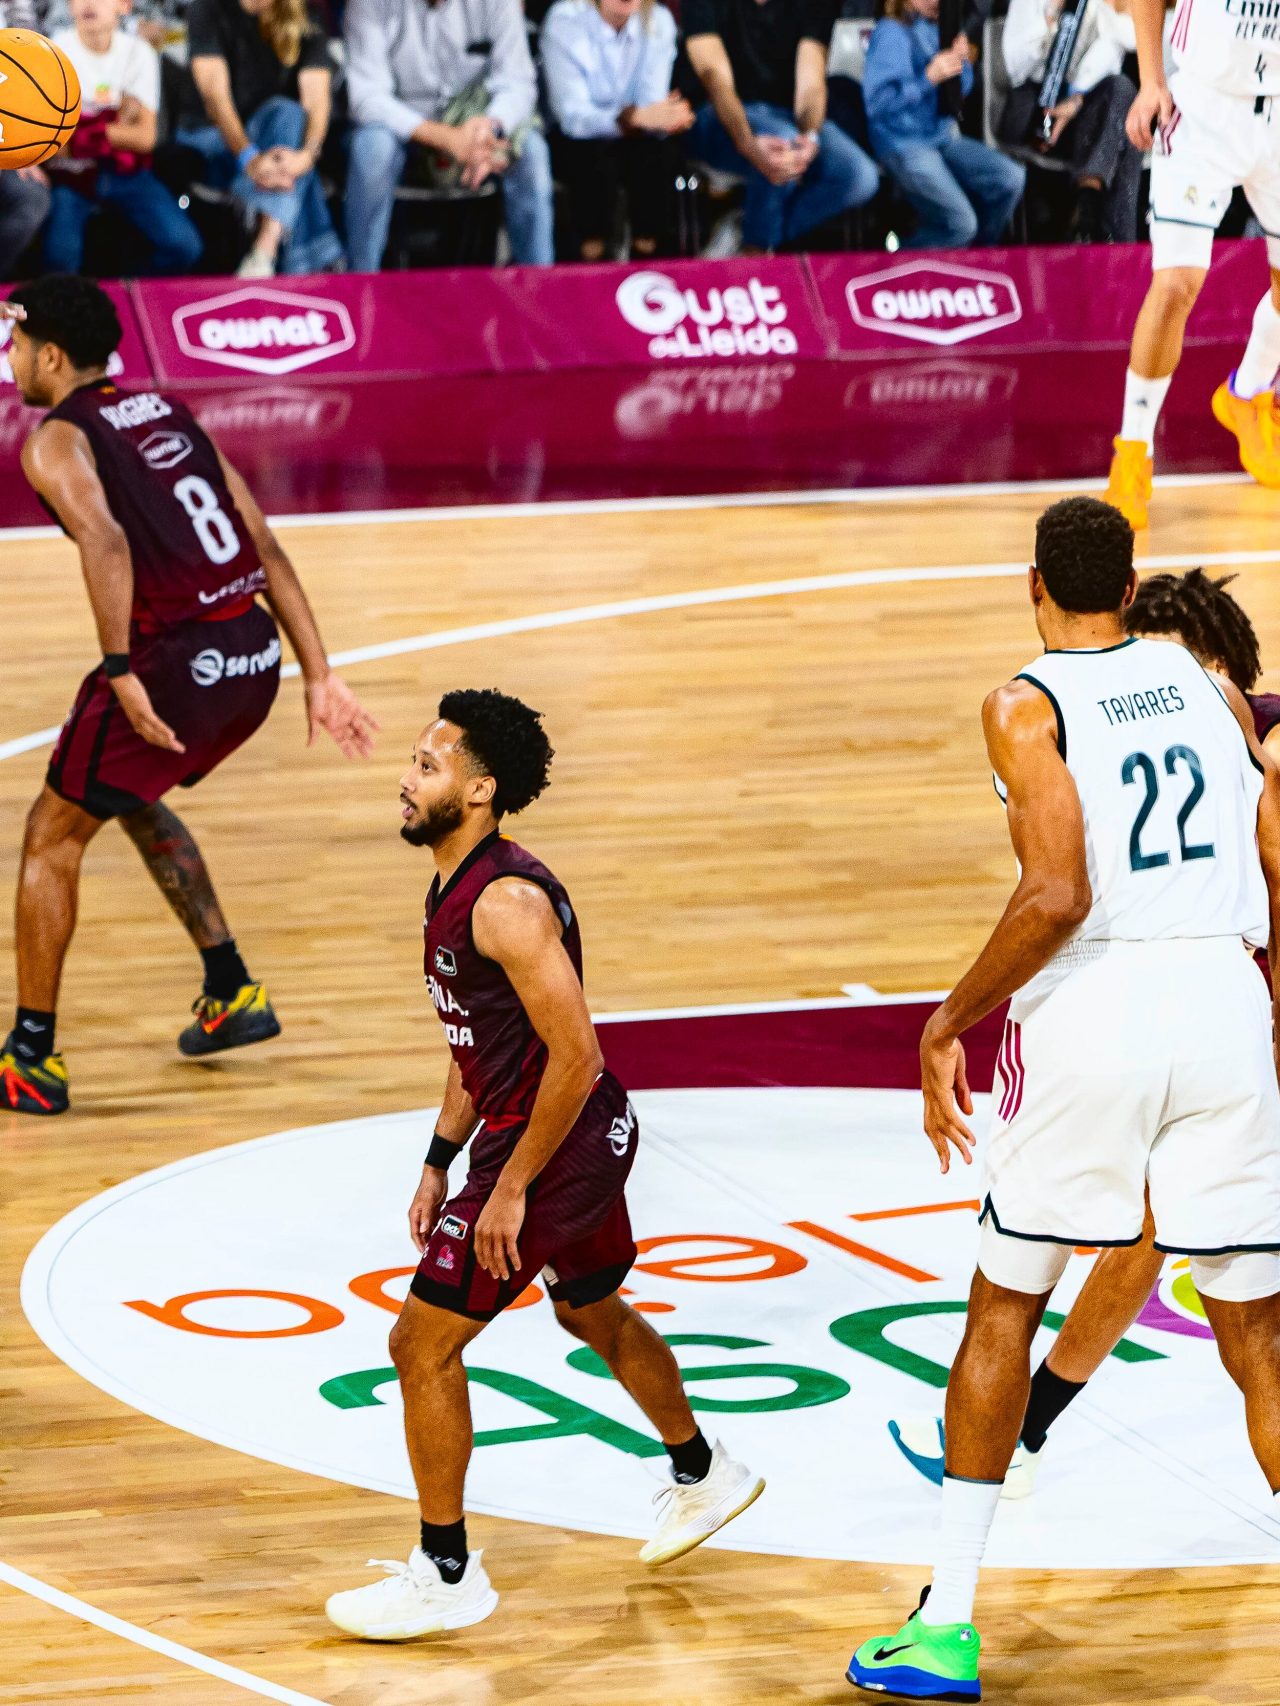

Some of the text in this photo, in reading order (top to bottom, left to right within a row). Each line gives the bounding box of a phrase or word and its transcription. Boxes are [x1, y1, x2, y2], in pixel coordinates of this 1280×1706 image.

[1254, 52, 1267, 84] 4
[615, 270, 787, 335] Gust
[871, 283, 999, 321] ownat
[199, 309, 331, 351] ownat
[174, 475, 240, 565] 8
[1097, 685, 1186, 727] TAVARES
[1120, 744, 1217, 875] 22
